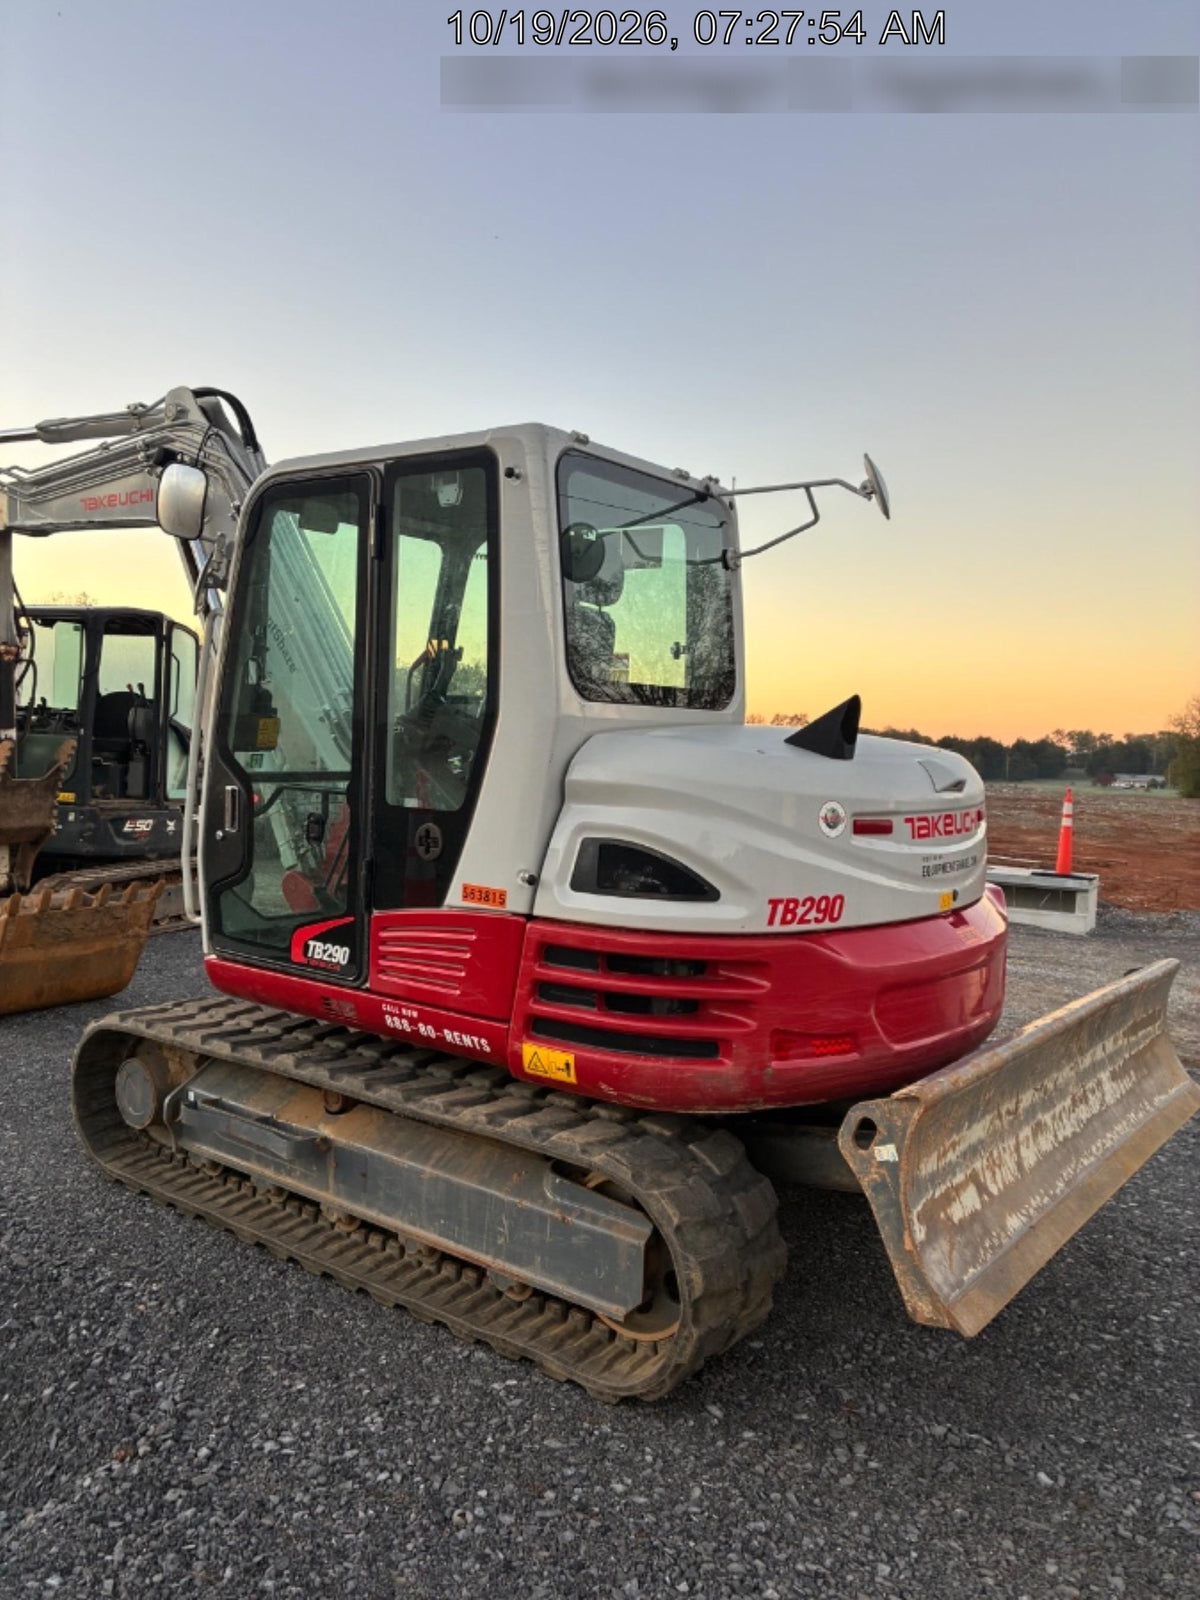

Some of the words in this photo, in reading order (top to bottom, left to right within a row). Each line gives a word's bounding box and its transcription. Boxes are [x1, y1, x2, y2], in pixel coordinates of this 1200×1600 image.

[903, 810, 981, 839] TAKEUCH
[767, 894, 845, 926] TB290
[307, 940, 350, 965] TB290
